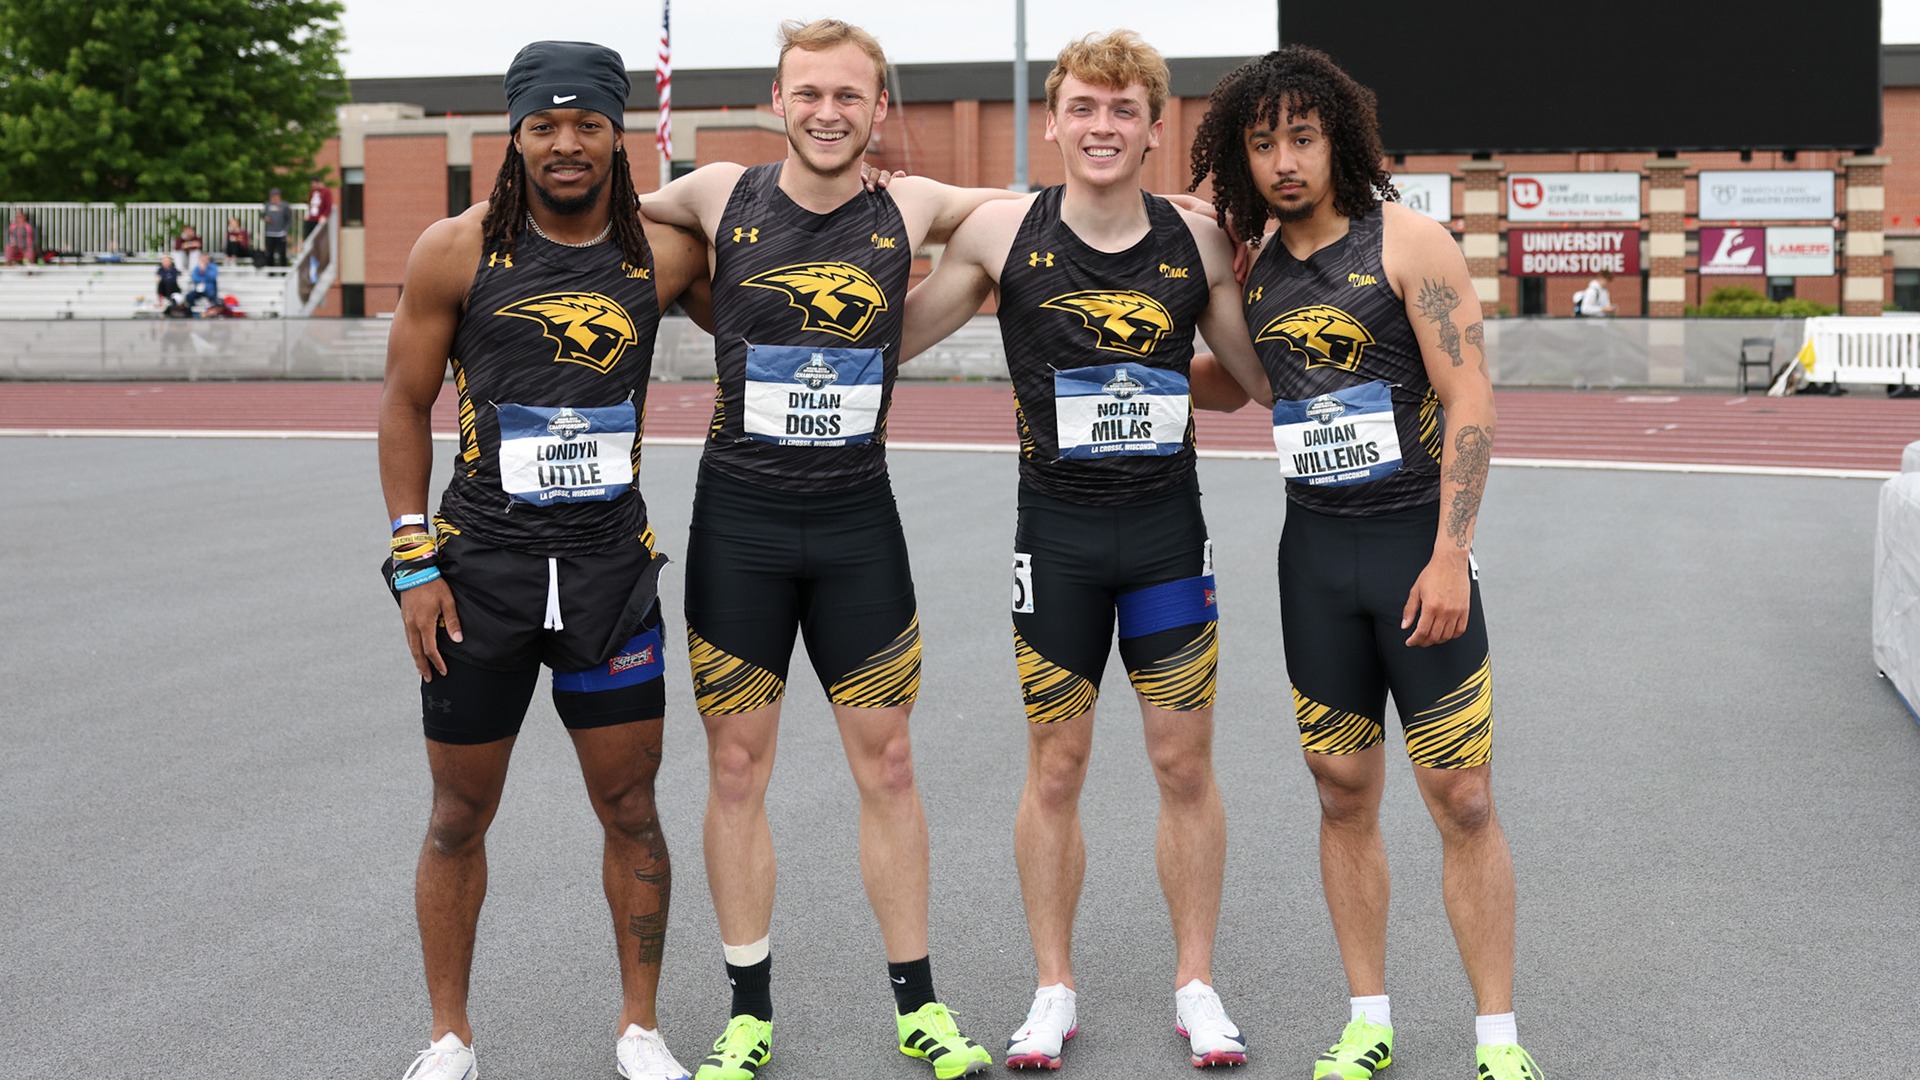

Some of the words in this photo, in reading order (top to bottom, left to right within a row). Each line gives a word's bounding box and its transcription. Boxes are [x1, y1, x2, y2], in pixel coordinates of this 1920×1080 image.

[1548, 184, 1569, 192] uw
[1548, 192, 1590, 204] credit
[1593, 192, 1637, 204] union
[1741, 196, 1781, 204] HEALTH
[1784, 196, 1821, 204] SYSTEM
[1522, 232, 1624, 252] UNIVERSITY
[1769, 243, 1830, 255] LAMERS
[1522, 253, 1625, 273] BOOKSTORE
[788, 392, 841, 409] DYLAN
[1097, 402, 1150, 418] NOLAN
[786, 414, 841, 436] DOSS
[1091, 420, 1152, 442] MILAS
[1303, 423, 1357, 448] DAVIAN
[537, 440, 598, 462] LONDYN
[1125, 443, 1157, 451] WISCONSIN
[1293, 441, 1380, 475] WILLEMS
[537, 463, 602, 488] LITTLE
[1338, 469, 1370, 482] WISCONSIN
[572, 488, 605, 497] WISCONSIN
